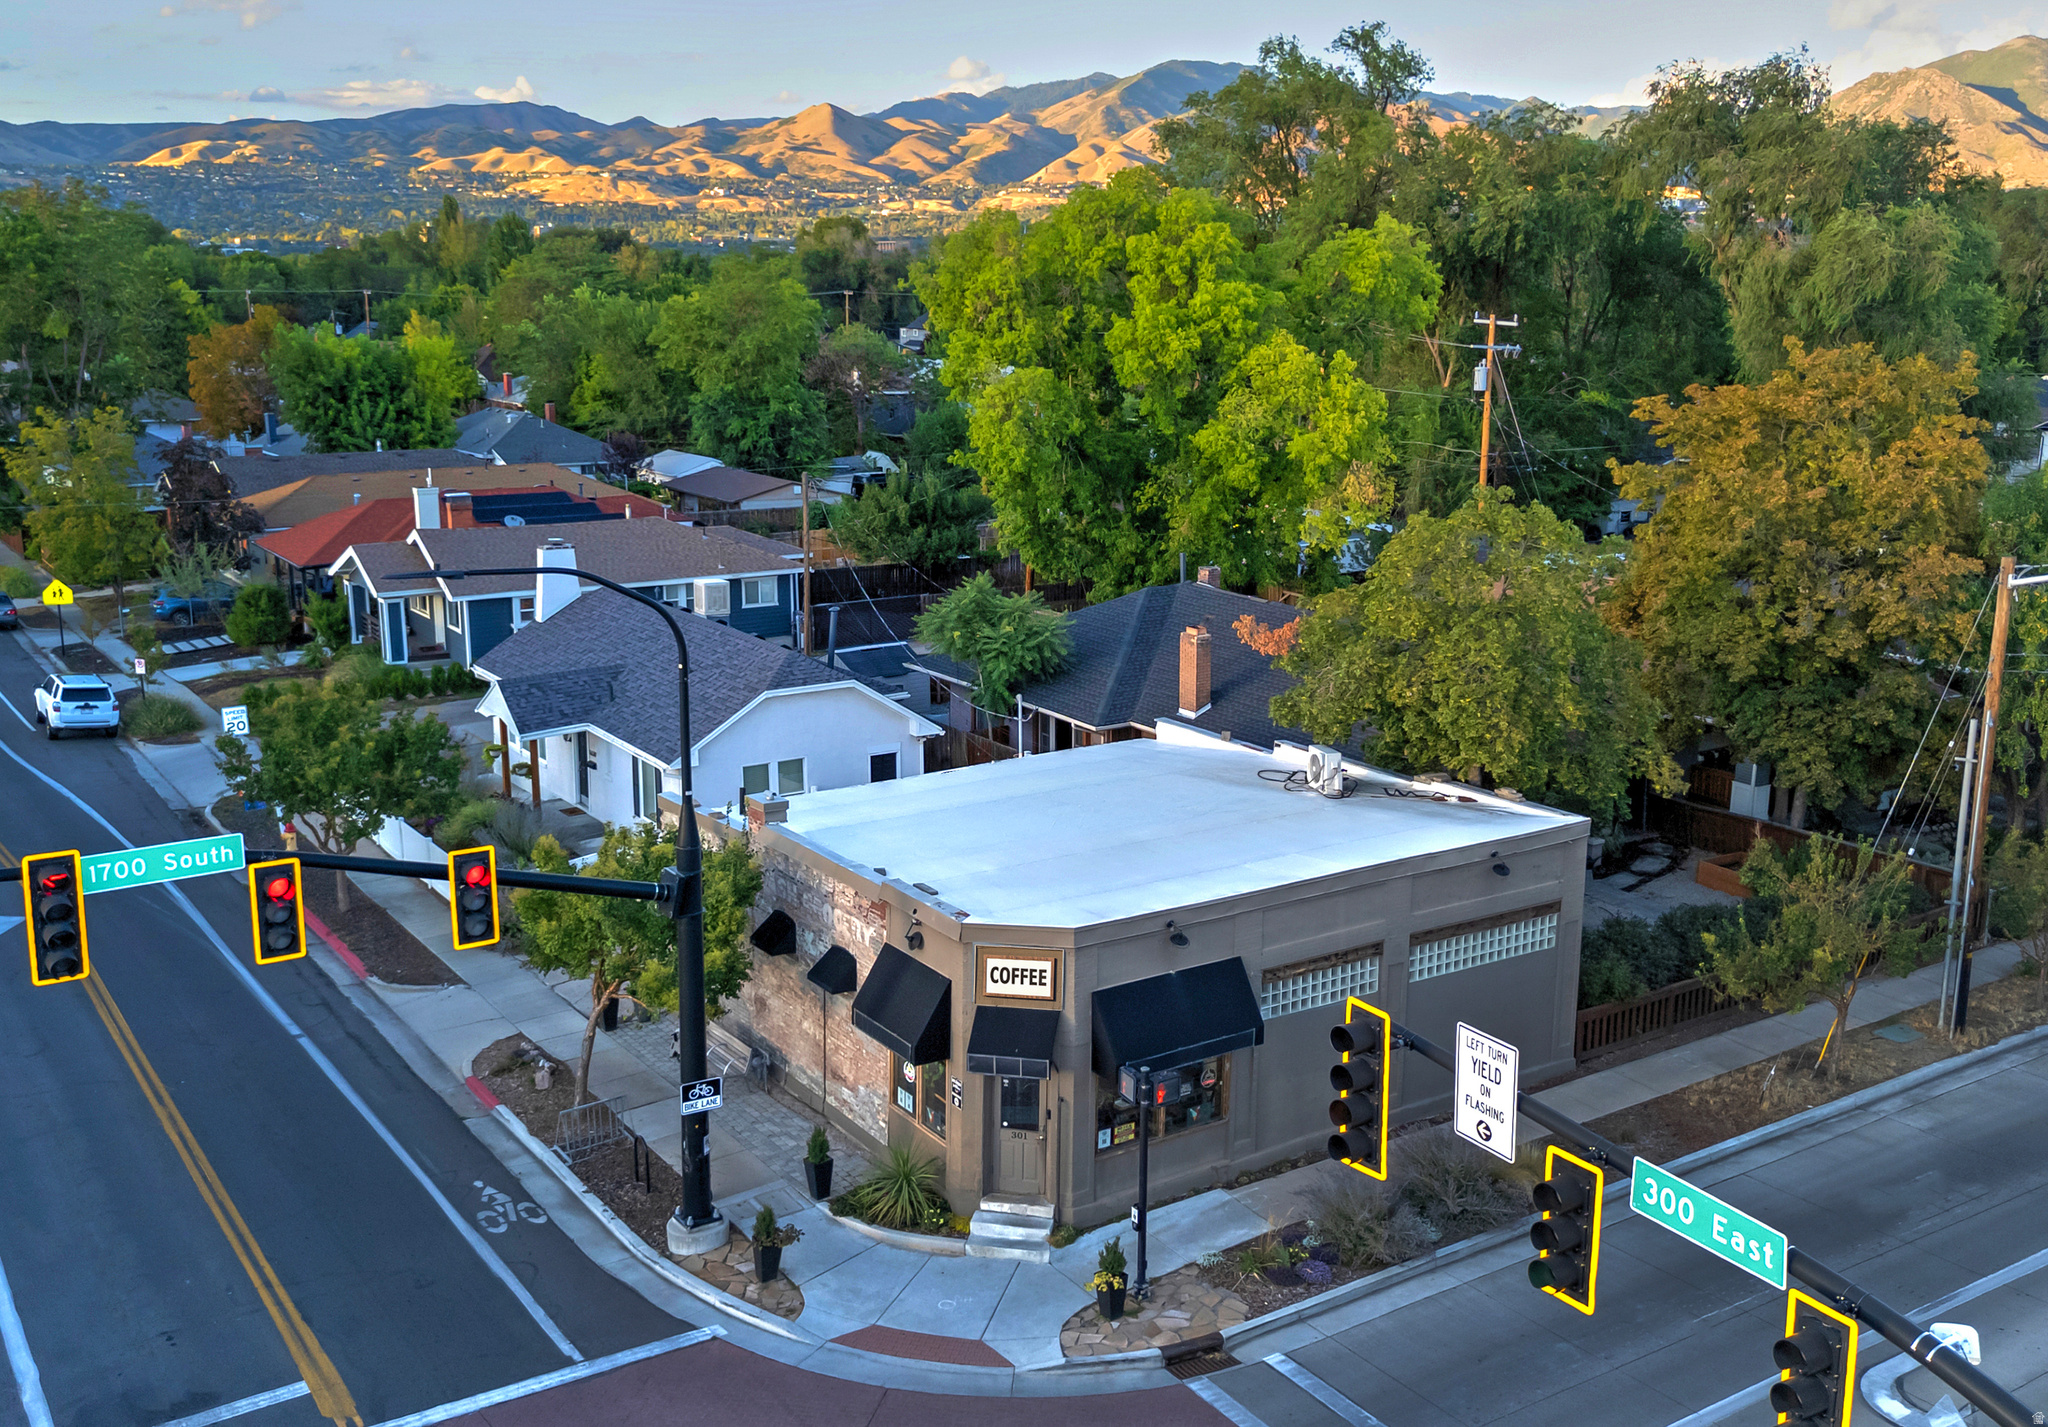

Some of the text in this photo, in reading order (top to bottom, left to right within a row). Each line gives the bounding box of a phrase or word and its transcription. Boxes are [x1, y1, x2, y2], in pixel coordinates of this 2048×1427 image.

[227, 721, 246, 732] 20
[88, 845, 234, 883] 1700 South
[990, 966, 1047, 986] COFFEE
[1466, 1035, 1508, 1066] LEFT TURN
[1471, 1055, 1502, 1086] YIELD
[1480, 1083, 1491, 1098] ON
[685, 1097, 718, 1111] BIKE LANE
[1465, 1093, 1505, 1124] FLASHING
[1011, 1131, 1028, 1140] 301
[1642, 1177, 1774, 1269] 300 East
